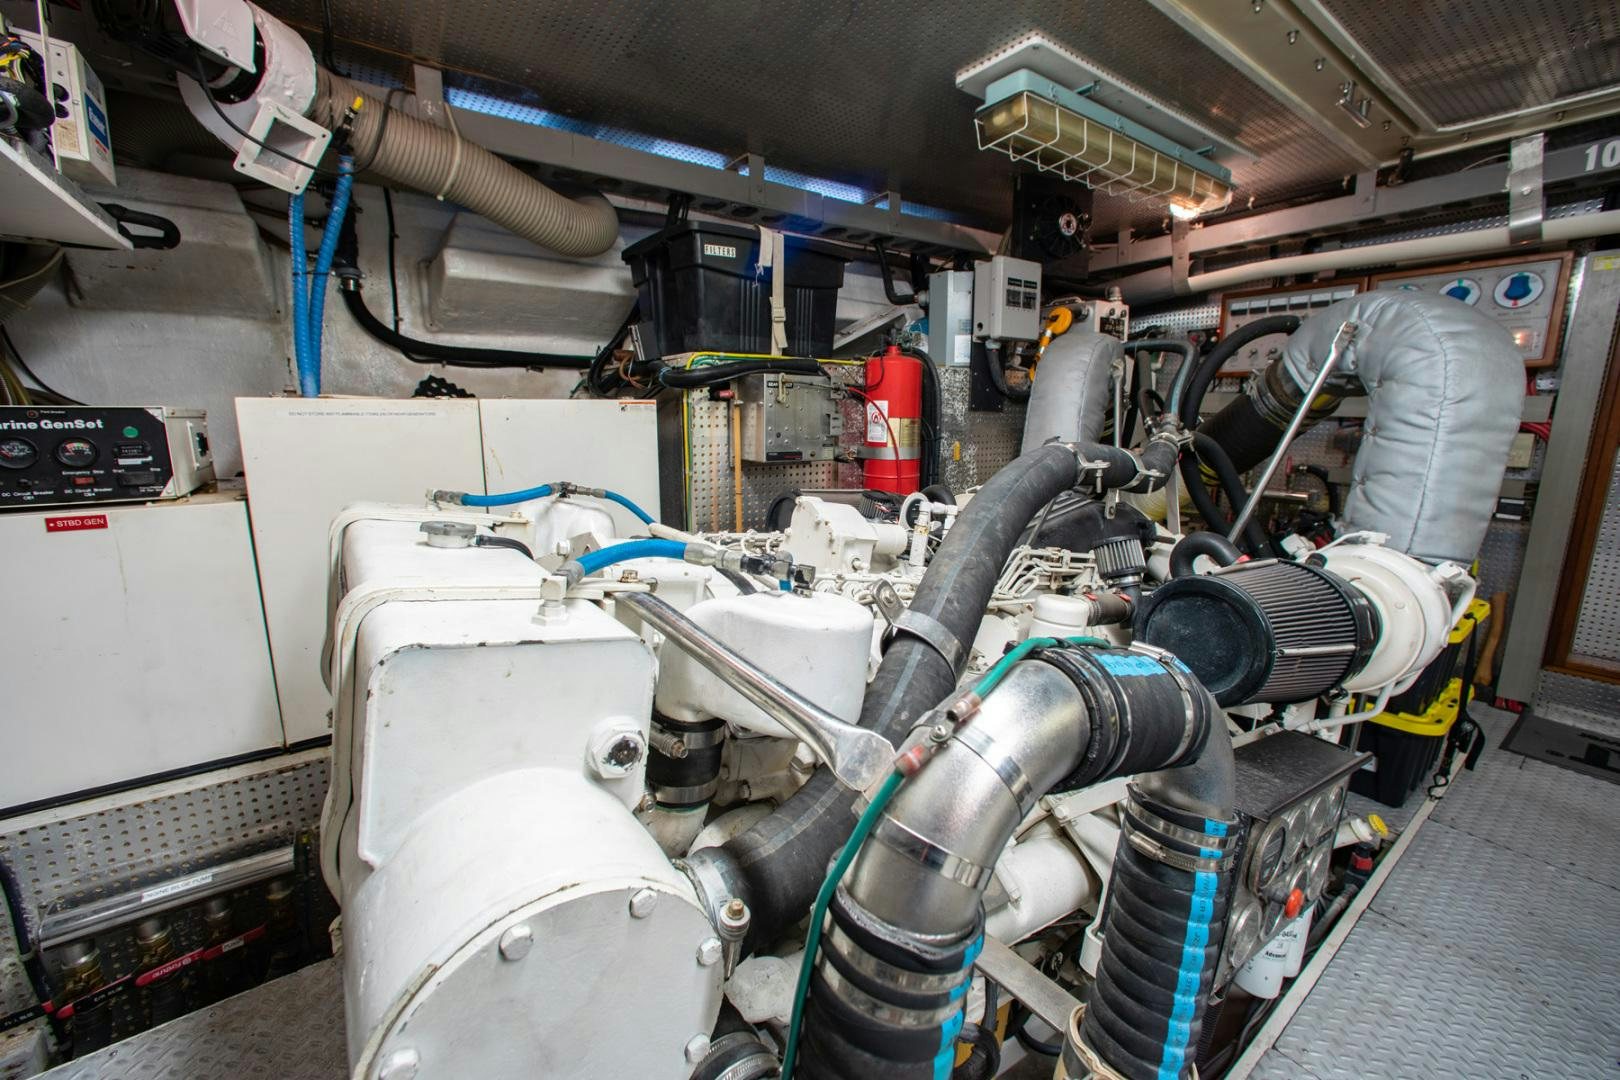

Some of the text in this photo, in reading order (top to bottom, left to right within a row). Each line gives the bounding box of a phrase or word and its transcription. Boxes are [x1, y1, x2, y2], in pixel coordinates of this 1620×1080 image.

[705, 245, 735, 257] FILTERS
[40, 419, 104, 430] GenSet
[56, 517, 105, 528] STBD GEN
